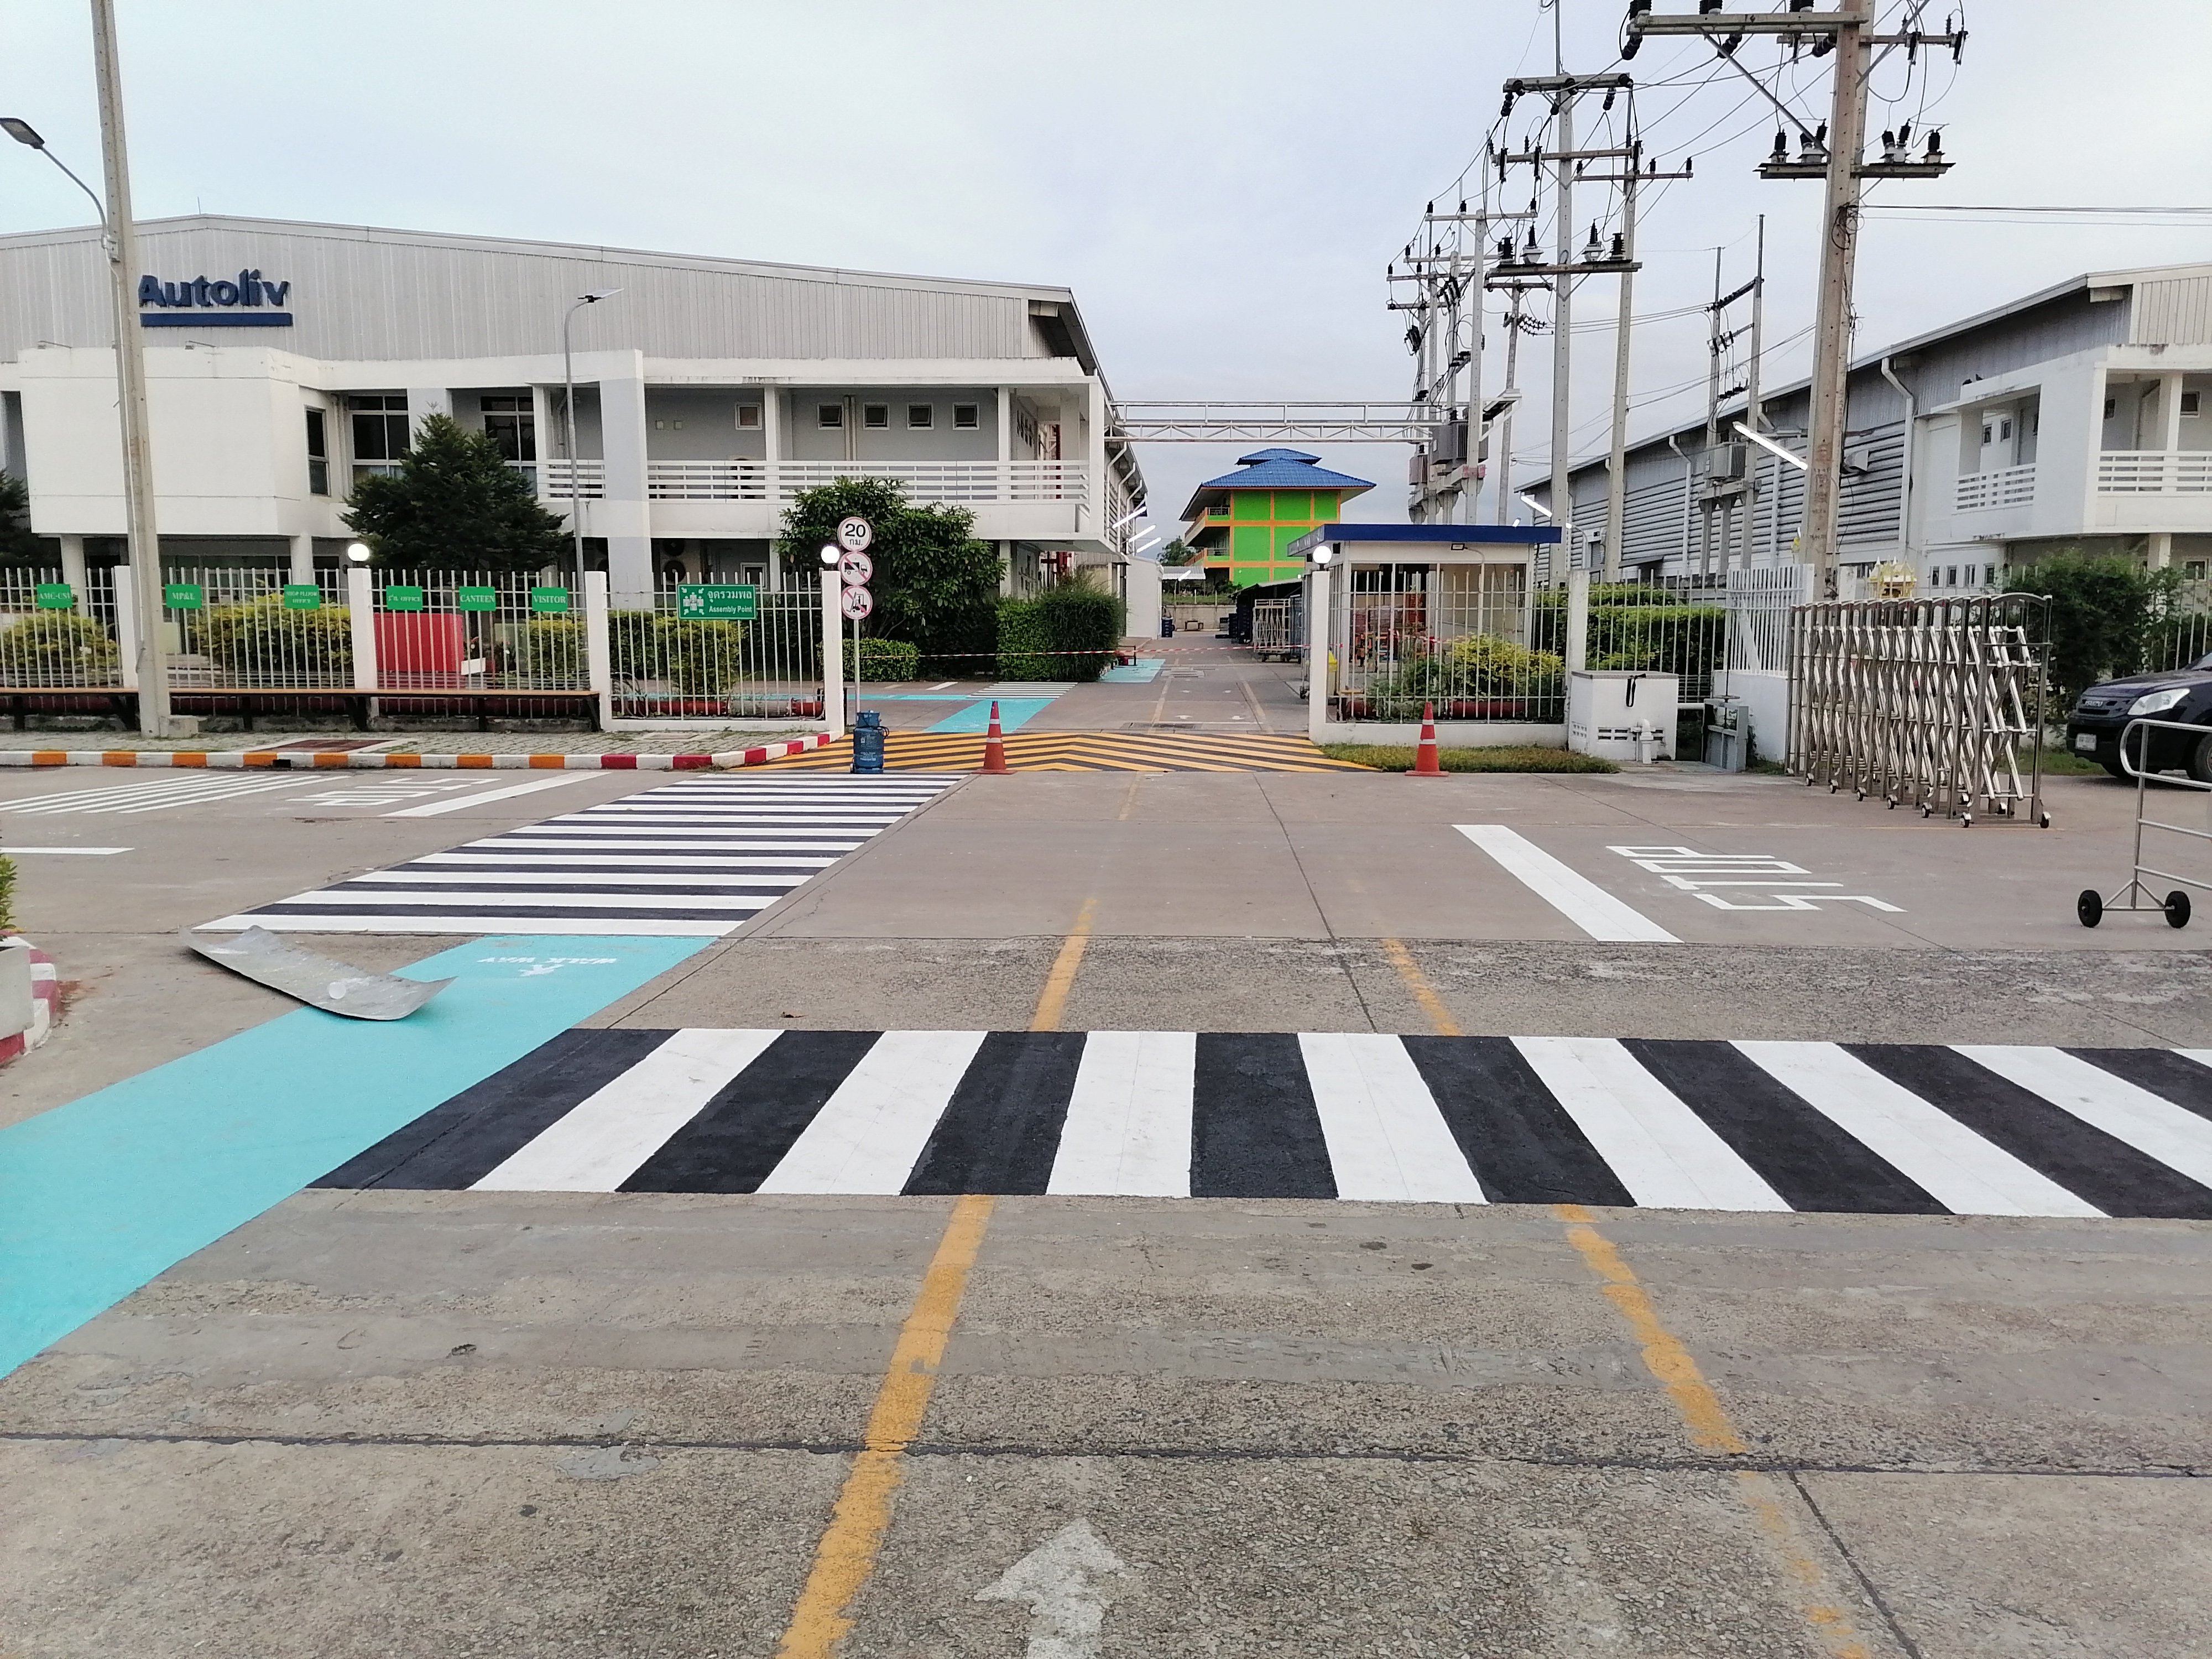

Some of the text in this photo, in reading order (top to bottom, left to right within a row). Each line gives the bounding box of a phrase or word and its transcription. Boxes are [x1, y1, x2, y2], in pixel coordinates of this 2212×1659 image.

[138, 269, 290, 307] Autoliv
[844, 523, 866, 538] 20
[460, 594, 495, 603] CANTEEN
[533, 595, 566, 603] VISITOR
[709, 606, 737, 614] Assembly
[285, 778, 502, 806] STOP
[1605, 846, 1908, 912] STOP
